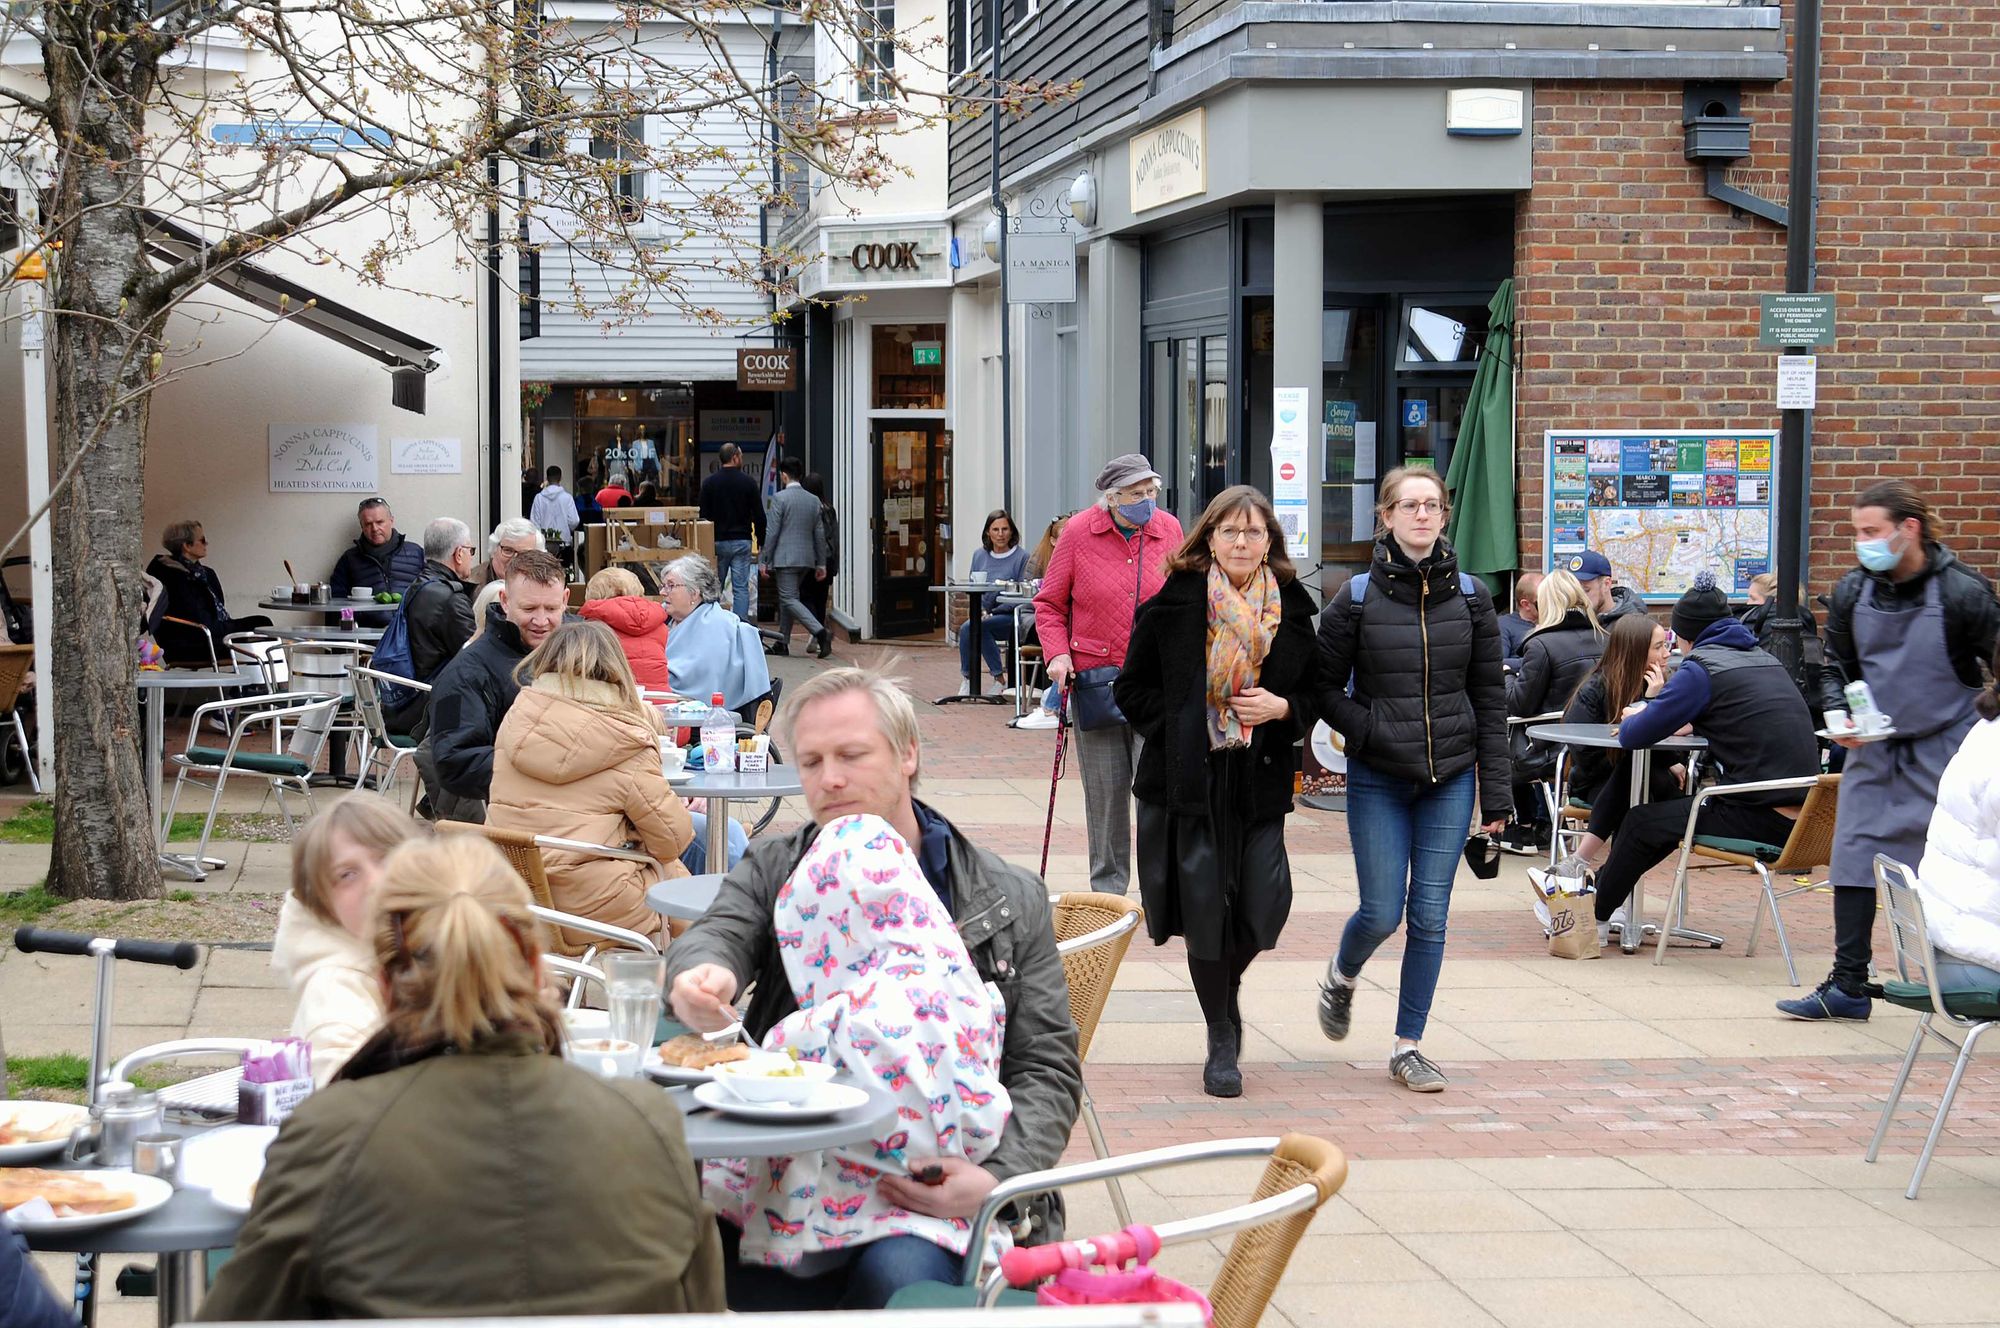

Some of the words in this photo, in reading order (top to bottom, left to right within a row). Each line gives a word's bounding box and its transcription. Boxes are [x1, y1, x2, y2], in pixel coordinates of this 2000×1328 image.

[852, 241, 919, 271] COOK
[744, 355, 790, 370] COOK
[1327, 424, 1353, 436] CLOSED
[273, 431, 310, 461] NONNA
[304, 443, 342, 456] Italian
[274, 481, 309, 489] HEATED
[311, 481, 348, 489] SEATING
[349, 481, 374, 489] AREA
